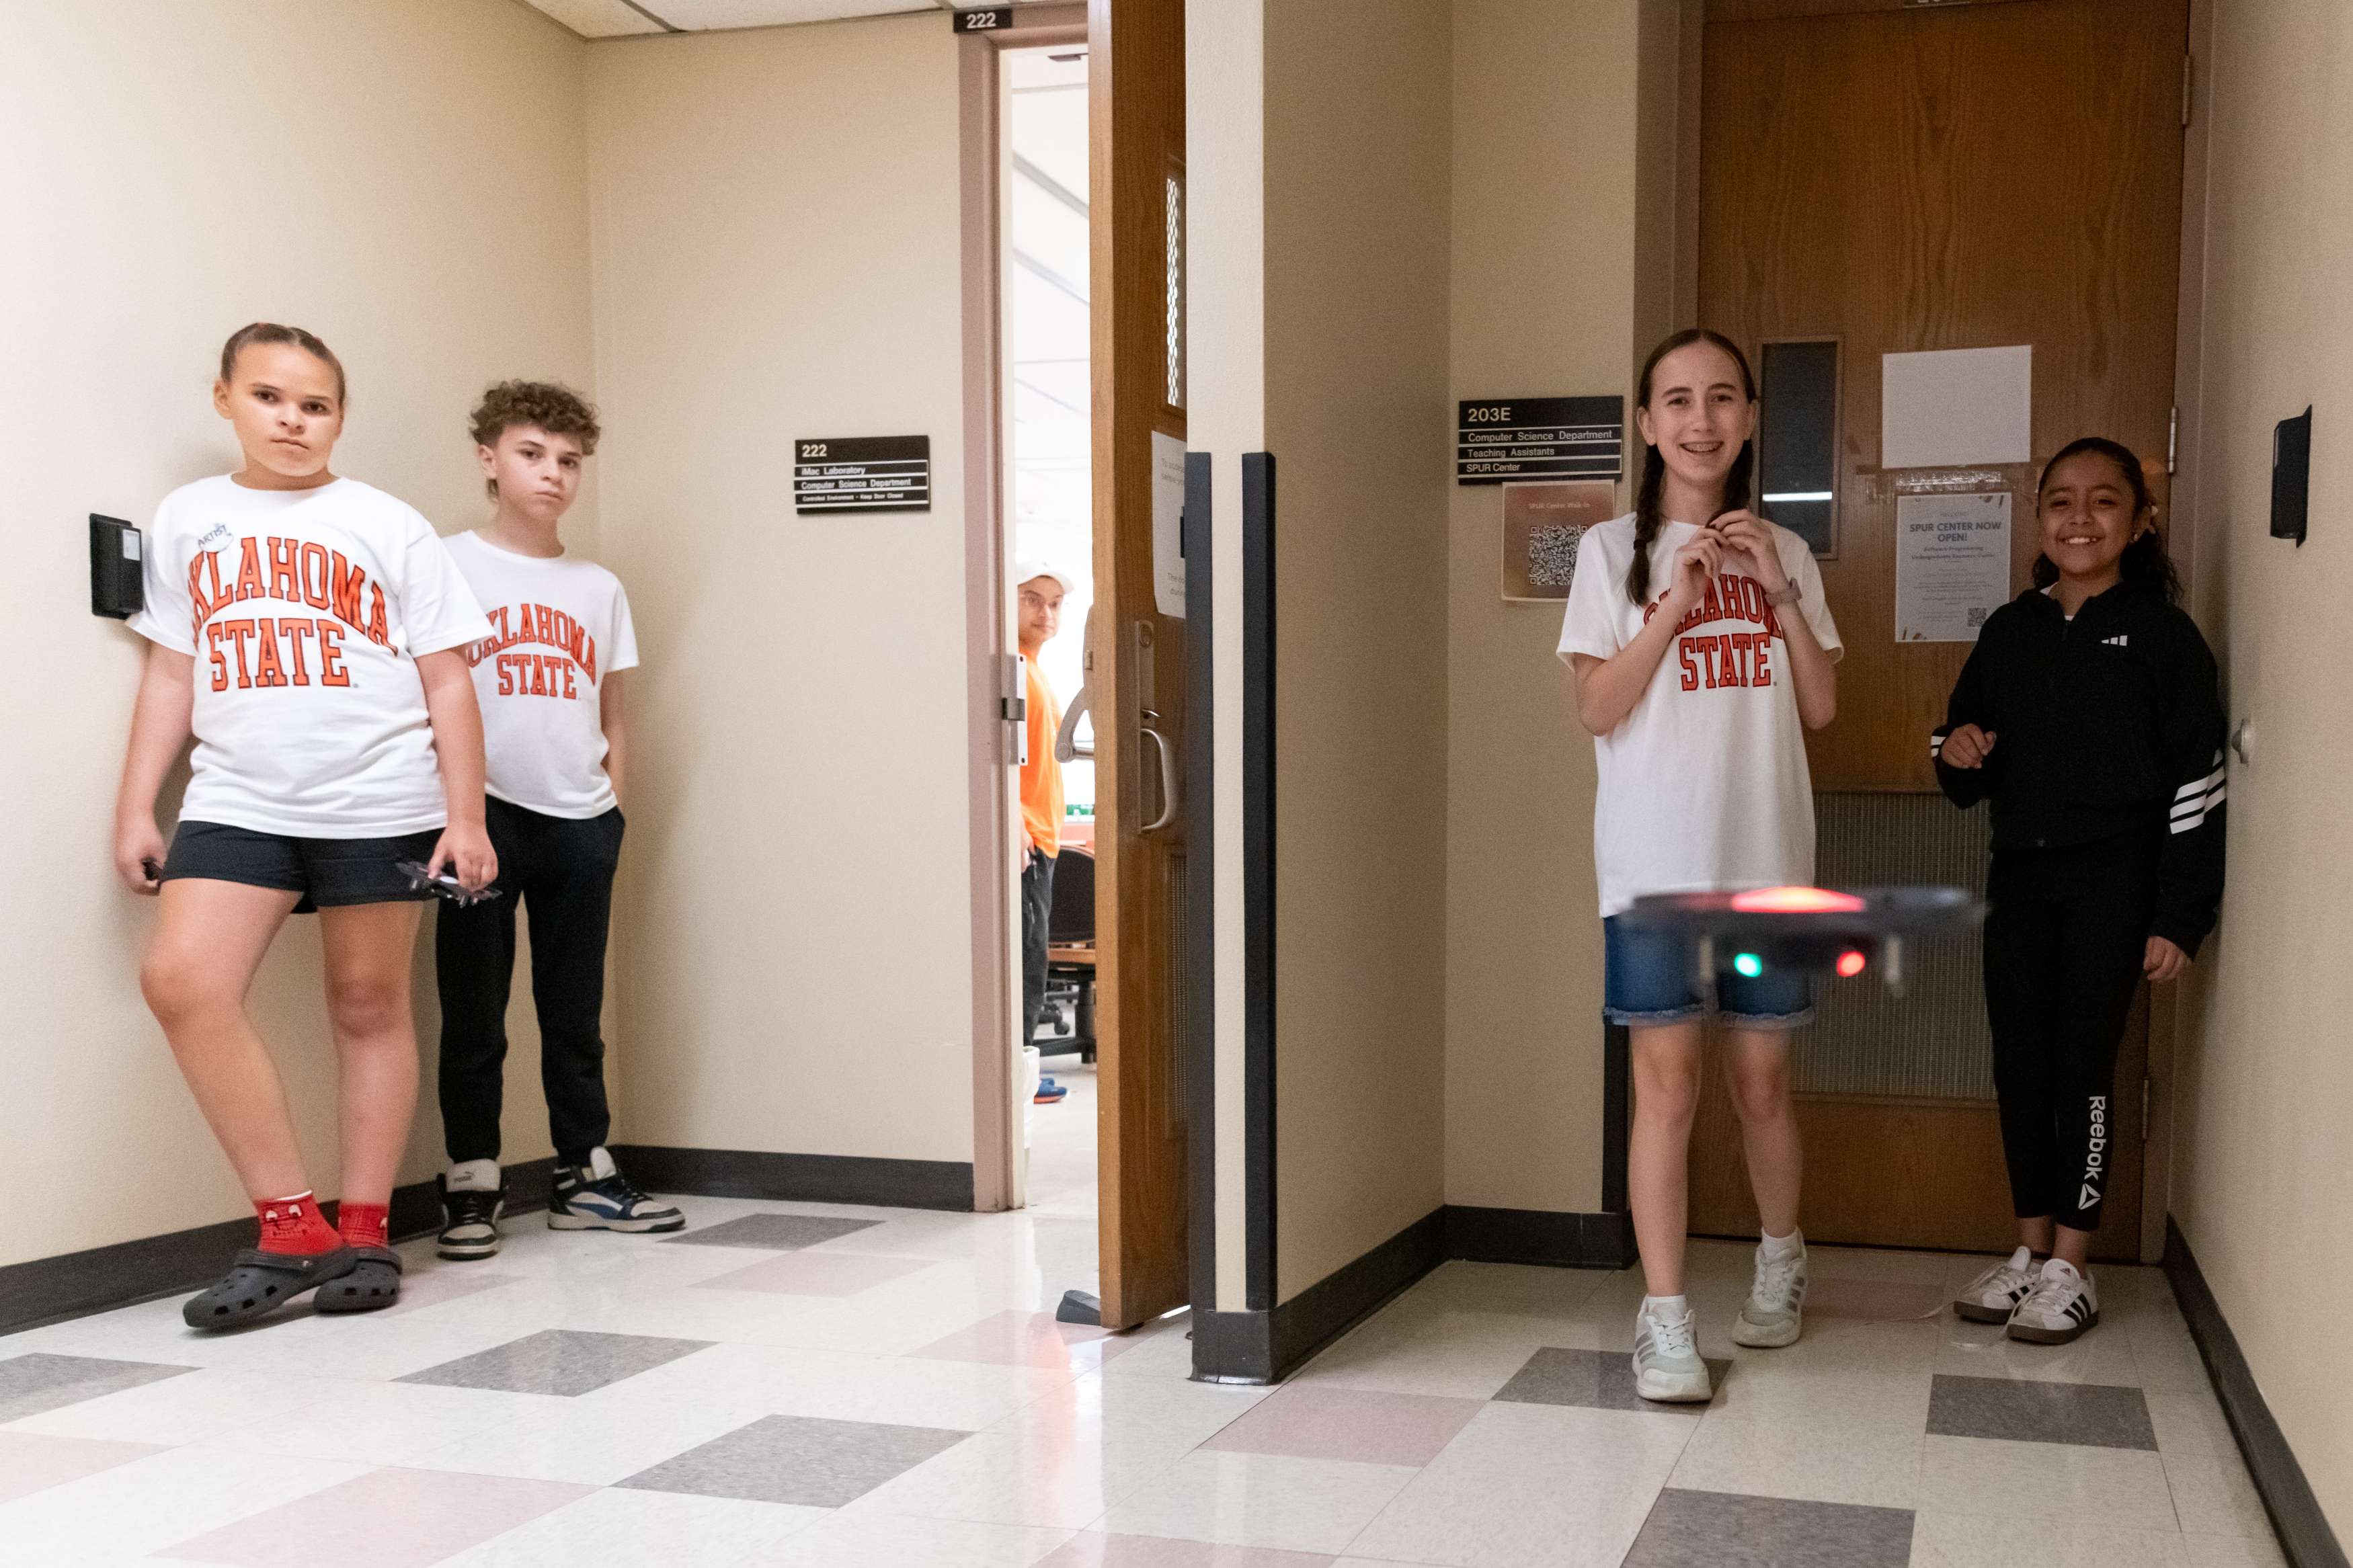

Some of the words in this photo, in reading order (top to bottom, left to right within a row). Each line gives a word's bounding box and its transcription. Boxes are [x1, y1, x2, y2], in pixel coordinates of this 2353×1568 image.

[966, 12, 996, 29] 222
[1468, 407, 1511, 422] 203E
[1468, 432, 1512, 443] Computer
[1517, 431, 1554, 441] Science
[1559, 430, 1613, 441] Department
[802, 444, 827, 458] 222
[1468, 448, 1506, 458] Teaching
[1511, 448, 1555, 457] Assistants
[801, 467, 820, 476] iMac
[824, 466, 866, 476] Laboratory
[1466, 464, 1491, 472] SPUR
[1492, 463, 1521, 472] Center
[801, 481, 835, 491] Computer
[838, 480, 867, 489] Science
[870, 478, 912, 488] Department
[1909, 523, 1934, 533] SPUR
[1937, 522, 1973, 532] CENTER
[1975, 521, 2001, 531] NOW
[1938, 533, 1968, 542] OPEN!
[206, 618, 350, 692] STATE
[1679, 632, 1771, 692] STATE
[496, 654, 577, 700] STATE
[2083, 1096, 2107, 1181] Reebok
